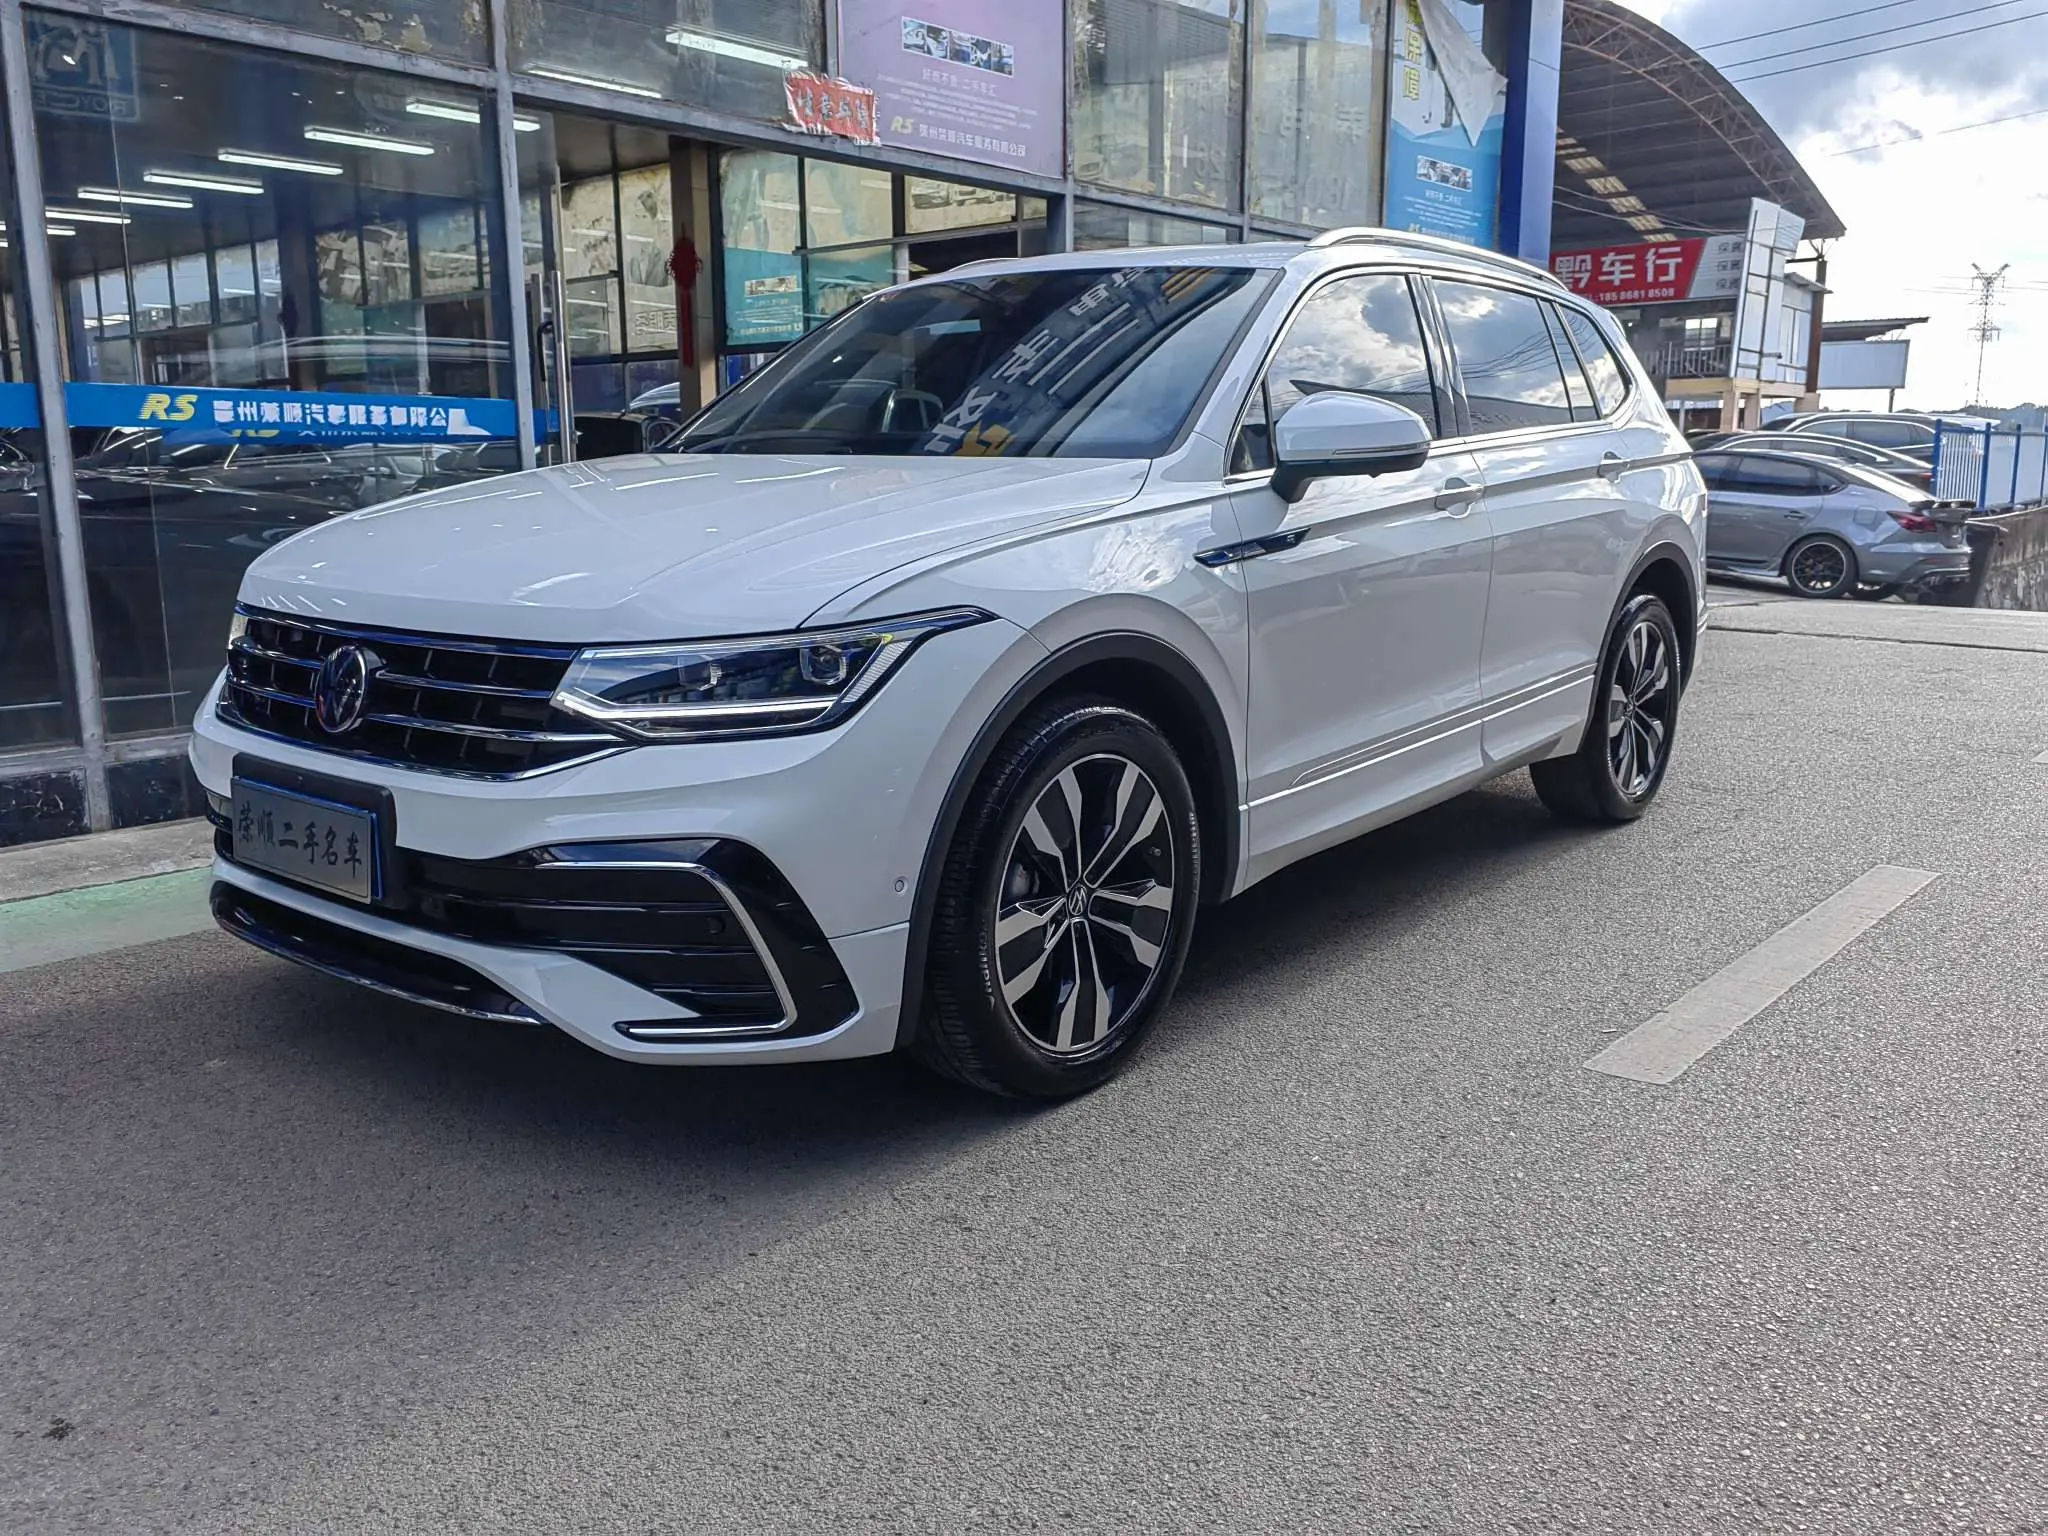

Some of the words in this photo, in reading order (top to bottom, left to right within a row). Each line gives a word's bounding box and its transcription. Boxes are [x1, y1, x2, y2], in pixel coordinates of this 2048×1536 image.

[1555, 247, 1683, 289] 黔车行
[139, 394, 197, 421] RS
